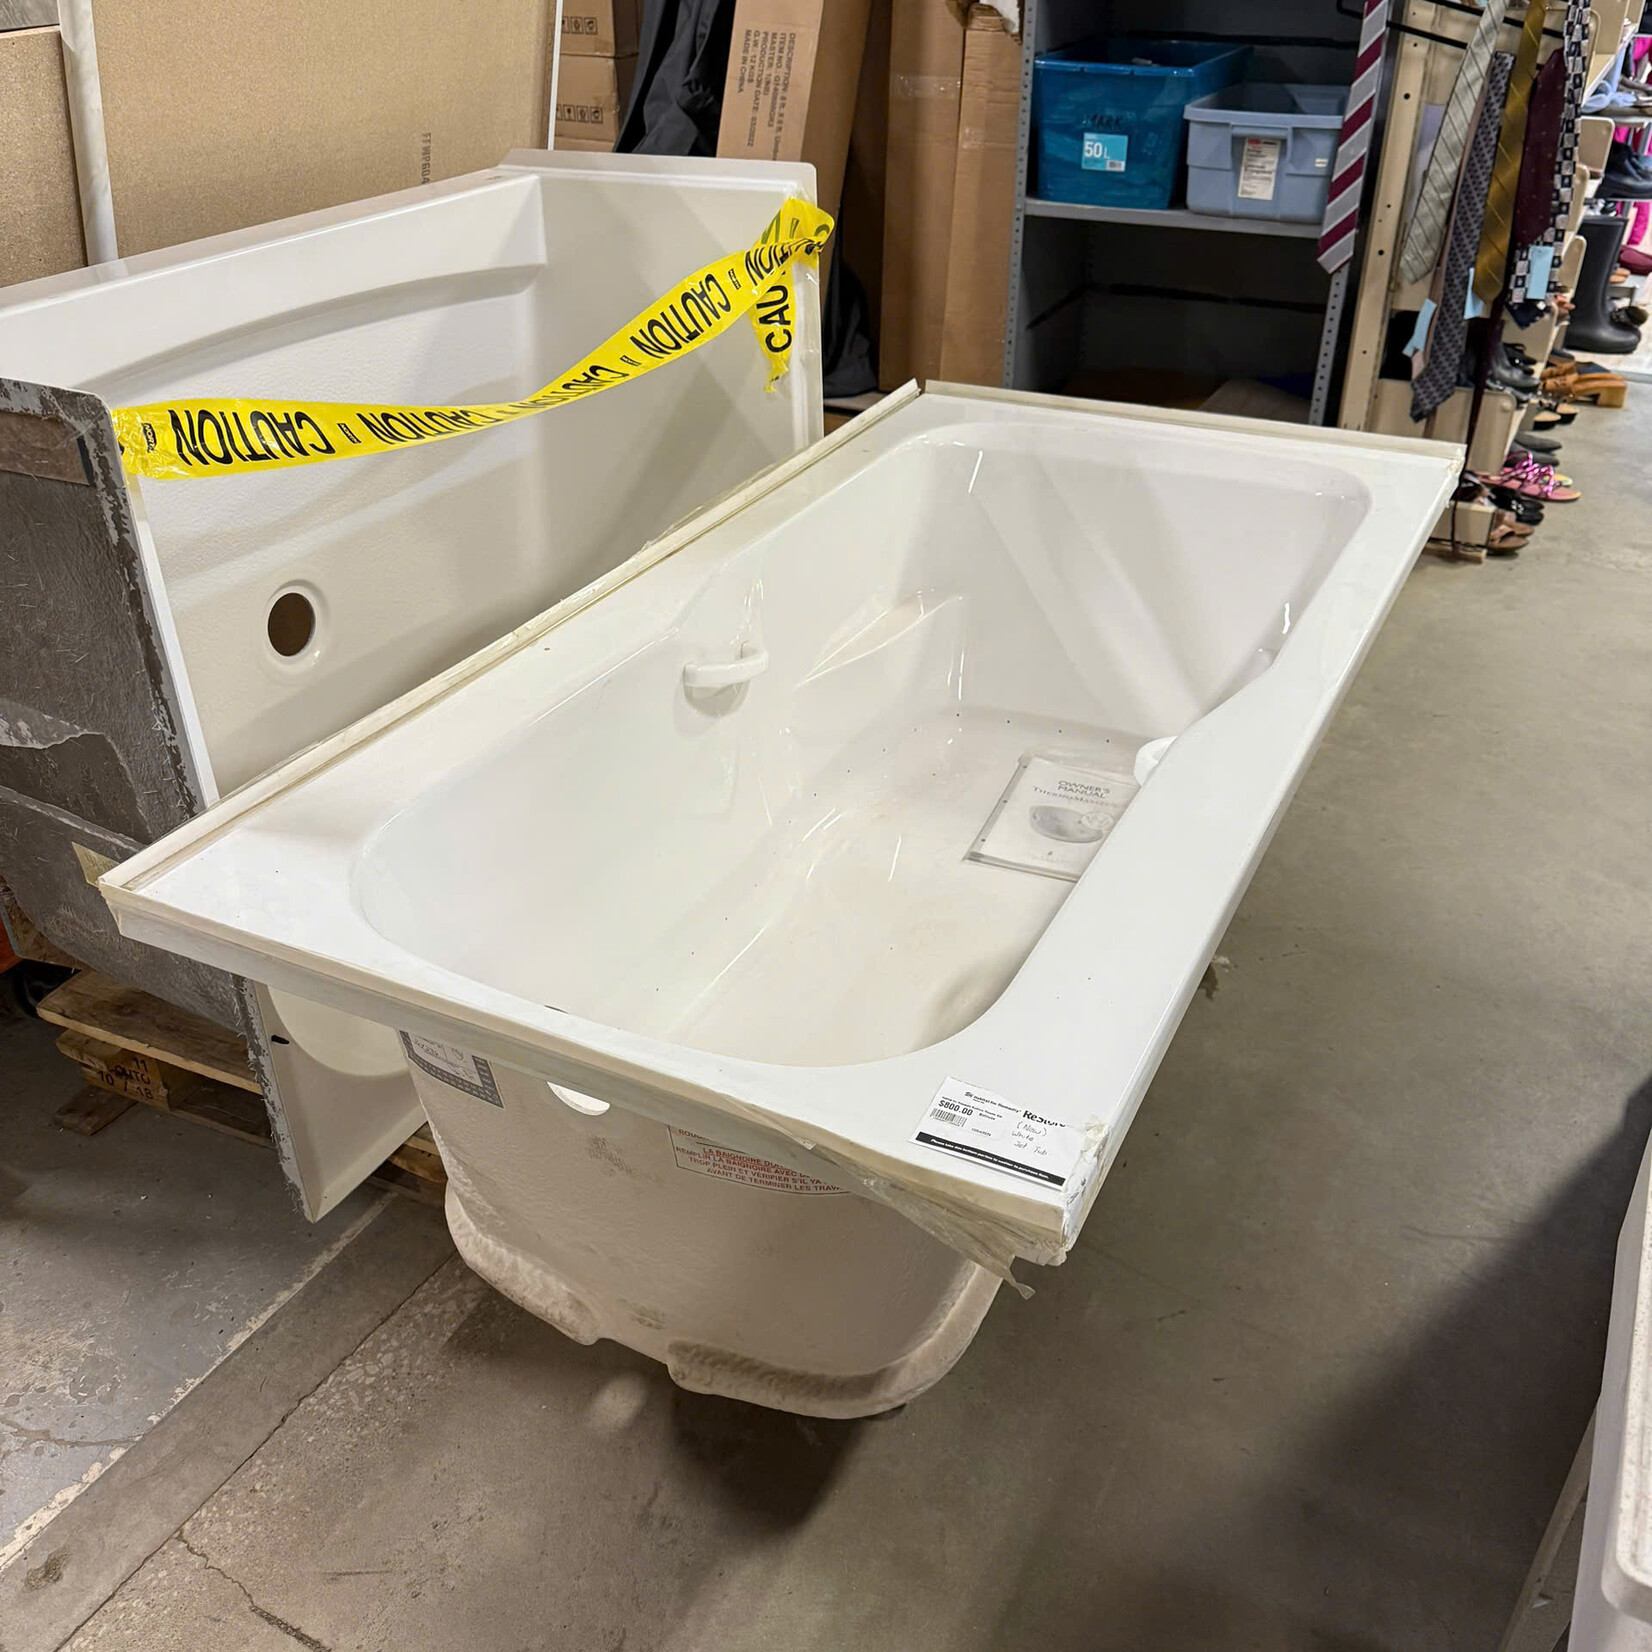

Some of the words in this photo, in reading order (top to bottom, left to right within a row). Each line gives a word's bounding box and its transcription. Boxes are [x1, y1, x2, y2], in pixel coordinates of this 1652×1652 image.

[742, 29, 752, 54] MADE
[741, 56, 748, 65] IN
[756, 31, 769, 88] PRODUCTION
[737, 66, 746, 92] CHINA
[629, 273, 732, 359] CAUTION
[356, 408, 504, 445] CAUTION
[167, 409, 335, 466] CAUTION
[1057, 785, 1107, 799] MANUAL
[1058, 780, 1111, 794] OWNER'S
[938, 1100, 973, 1116] $800.00
[1012, 1130, 1034, 1141] White
[716, 1150, 761, 1165] BAIGNOIRE
[1034, 1146, 1048, 1155] Tub
[676, 1147, 710, 1160] REMPLIR
[713, 1156, 724, 1164] LA
[726, 1159, 771, 1173] BAIGNOIRE
[774, 1169, 797, 1177] AVEC
[689, 1157, 710, 1166] TROP
[713, 1163, 736, 1171] PLEIN
[707, 1168, 732, 1178] AVANT
[749, 1177, 791, 1188] TERMINER
